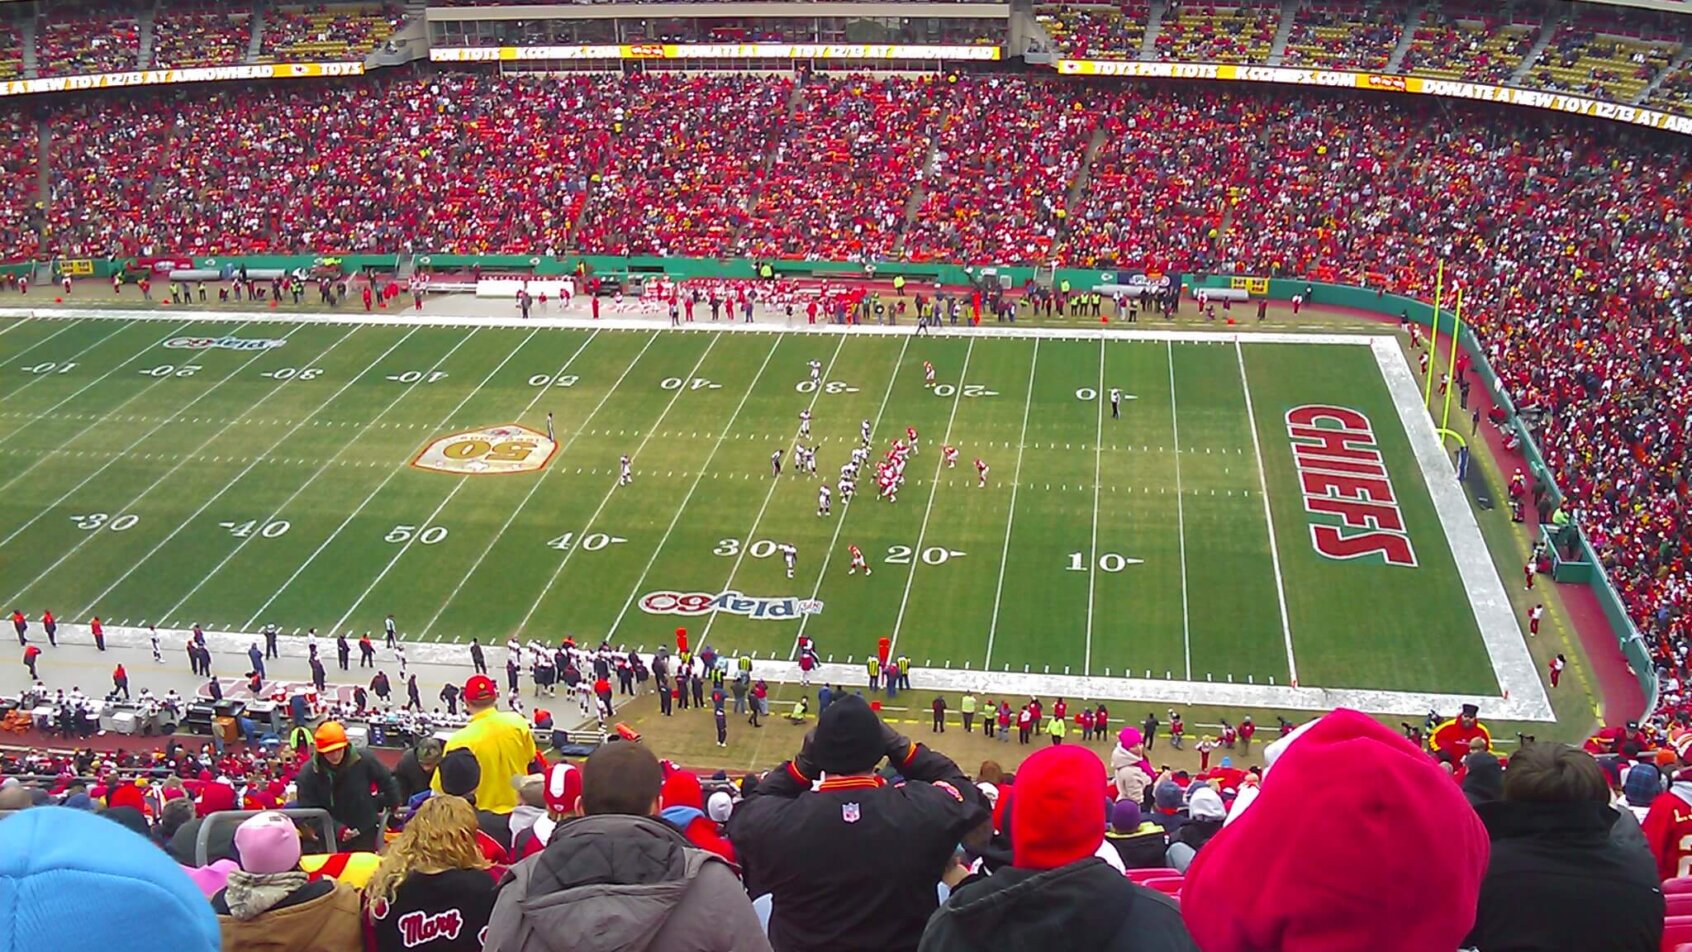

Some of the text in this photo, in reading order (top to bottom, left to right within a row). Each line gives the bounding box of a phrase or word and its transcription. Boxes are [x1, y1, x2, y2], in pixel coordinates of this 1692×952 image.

[321, 62, 362, 76] TOYS
[1094, 62, 1138, 75] TOYS
[1177, 64, 1217, 77] TOTS
[12, 81, 25, 94] A
[27, 77, 66, 92] NEW
[69, 75, 103, 90] TOY
[105, 72, 143, 87] 12/13
[146, 70, 169, 84] AT
[172, 65, 274, 82] ARROWHEAD
[1422, 79, 1496, 102] DONATE
[1496, 88, 1511, 102] A
[1513, 89, 1553, 109] NEW
[1556, 96, 1593, 114] TOY
[1596, 102, 1636, 122] 12/13
[1636, 110, 1664, 127] AT
[33, 362, 79, 374] 10
[152, 365, 202, 377] 20
[273, 368, 323, 380] 30
[400, 371, 448, 383] 40
[528, 374, 579, 387] 50
[661, 378, 710, 390] 40
[796, 381, 846, 394] 30
[934, 384, 984, 397] 20
[443, 440, 538, 461] 50
[1285, 404, 1418, 567] CHIEFS
[78, 513, 139, 531] 30
[230, 520, 290, 538] 40
[385, 525, 448, 544] 50
[547, 532, 610, 550] 40
[713, 538, 777, 558] 30
[884, 545, 949, 565] 20
[1065, 552, 1126, 572] 10
[398, 908, 463, 947] Mary
